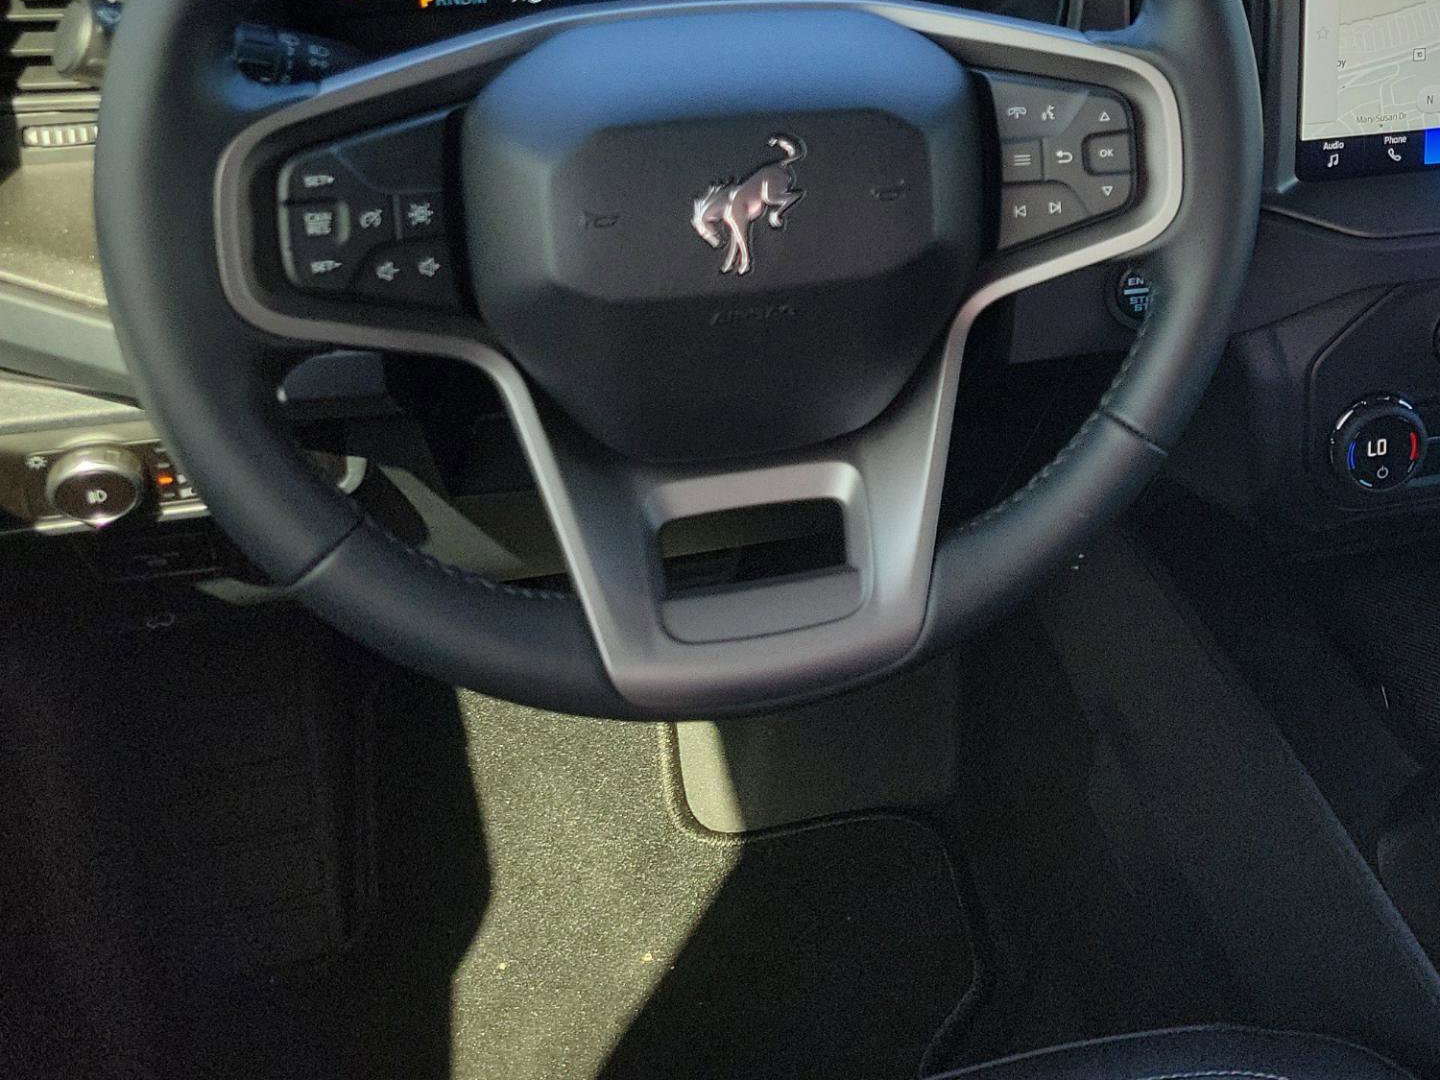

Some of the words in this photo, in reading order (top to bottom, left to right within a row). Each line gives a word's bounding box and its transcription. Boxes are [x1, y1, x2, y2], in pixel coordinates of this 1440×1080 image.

[1426, 95, 1434, 105] N
[1384, 135, 1407, 145] Phone
[1323, 141, 1345, 151] Audio
[1100, 149, 1114, 158] OK
[1367, 438, 1388, 457] LO
